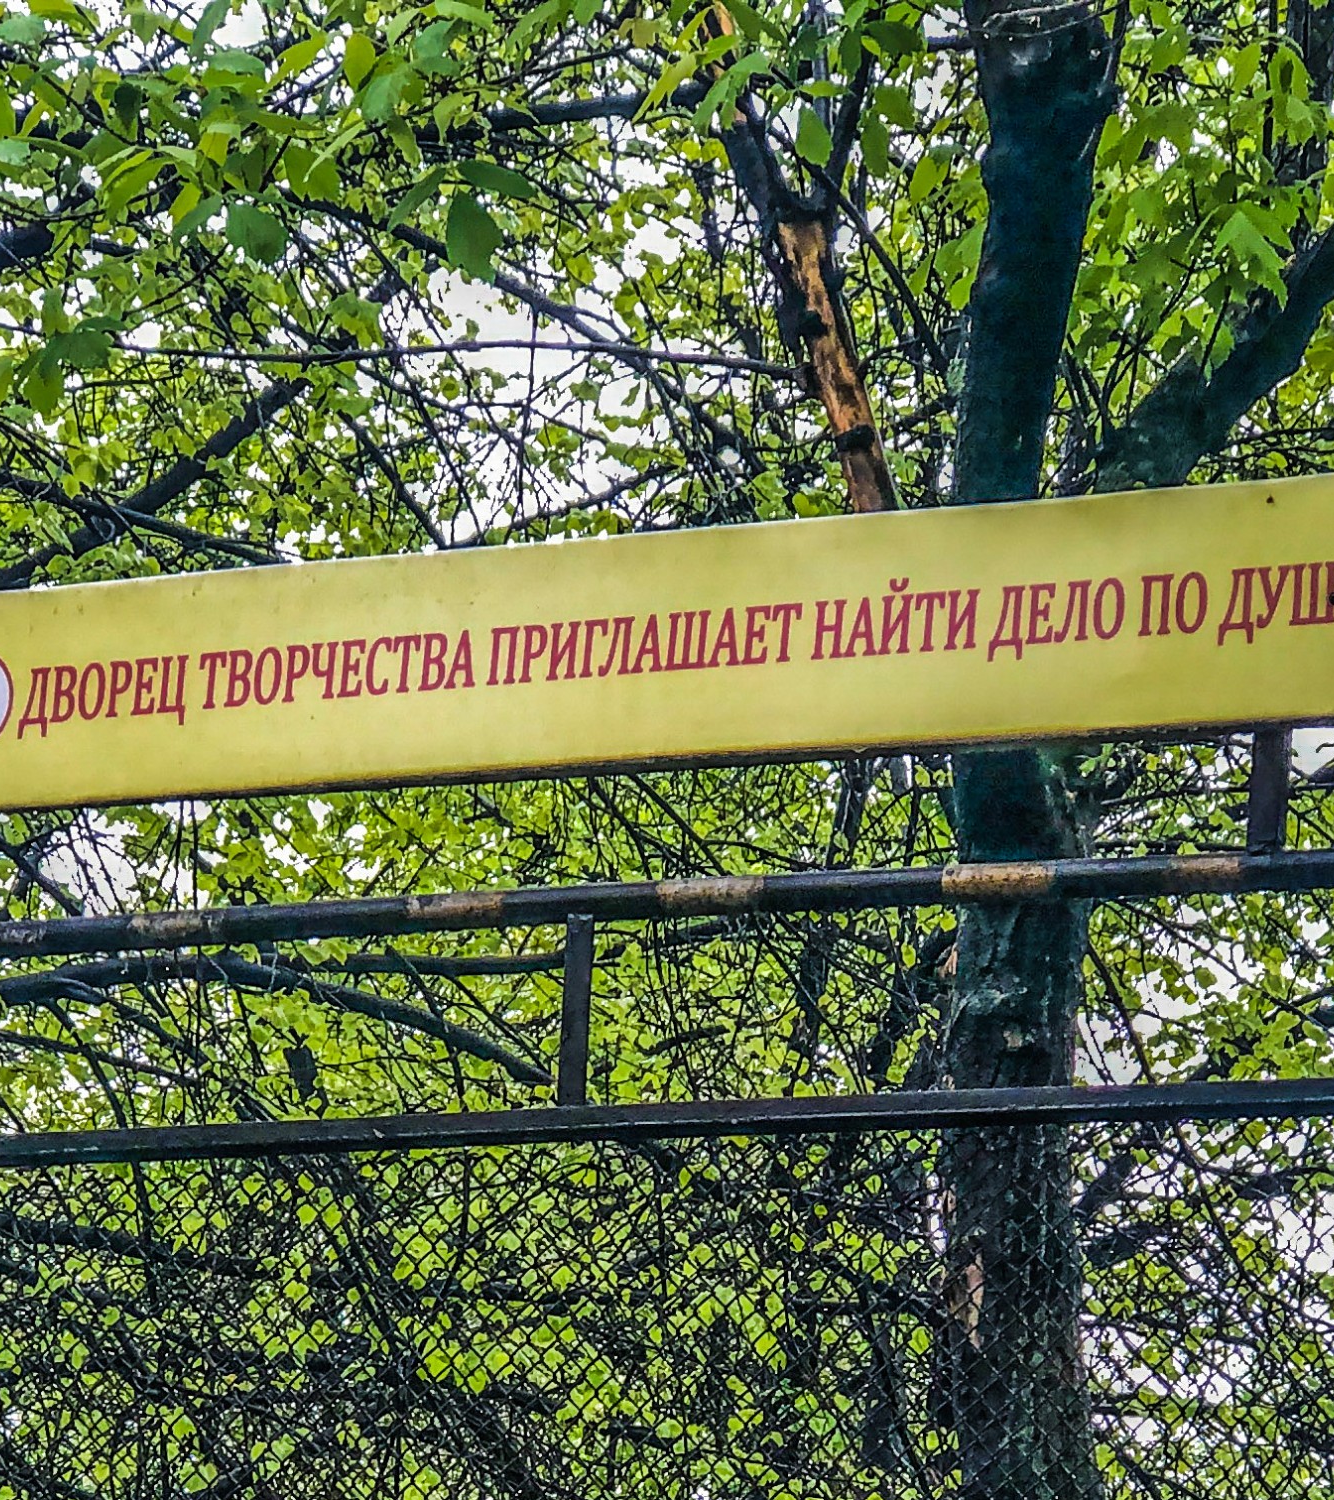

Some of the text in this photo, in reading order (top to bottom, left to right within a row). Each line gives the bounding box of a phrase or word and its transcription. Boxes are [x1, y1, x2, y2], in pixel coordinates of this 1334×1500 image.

[17, 654, 190, 738] ДВОРЕЦ
[198, 630, 475, 710] ТВОРЧЕСТВА
[487, 603, 804, 686] ПРИГЛАШАЕТ
[811, 577, 980, 660] НАЙТИ
[987, 577, 1125, 661] ДЕЛО
[1139, 572, 1208, 637] ПО
